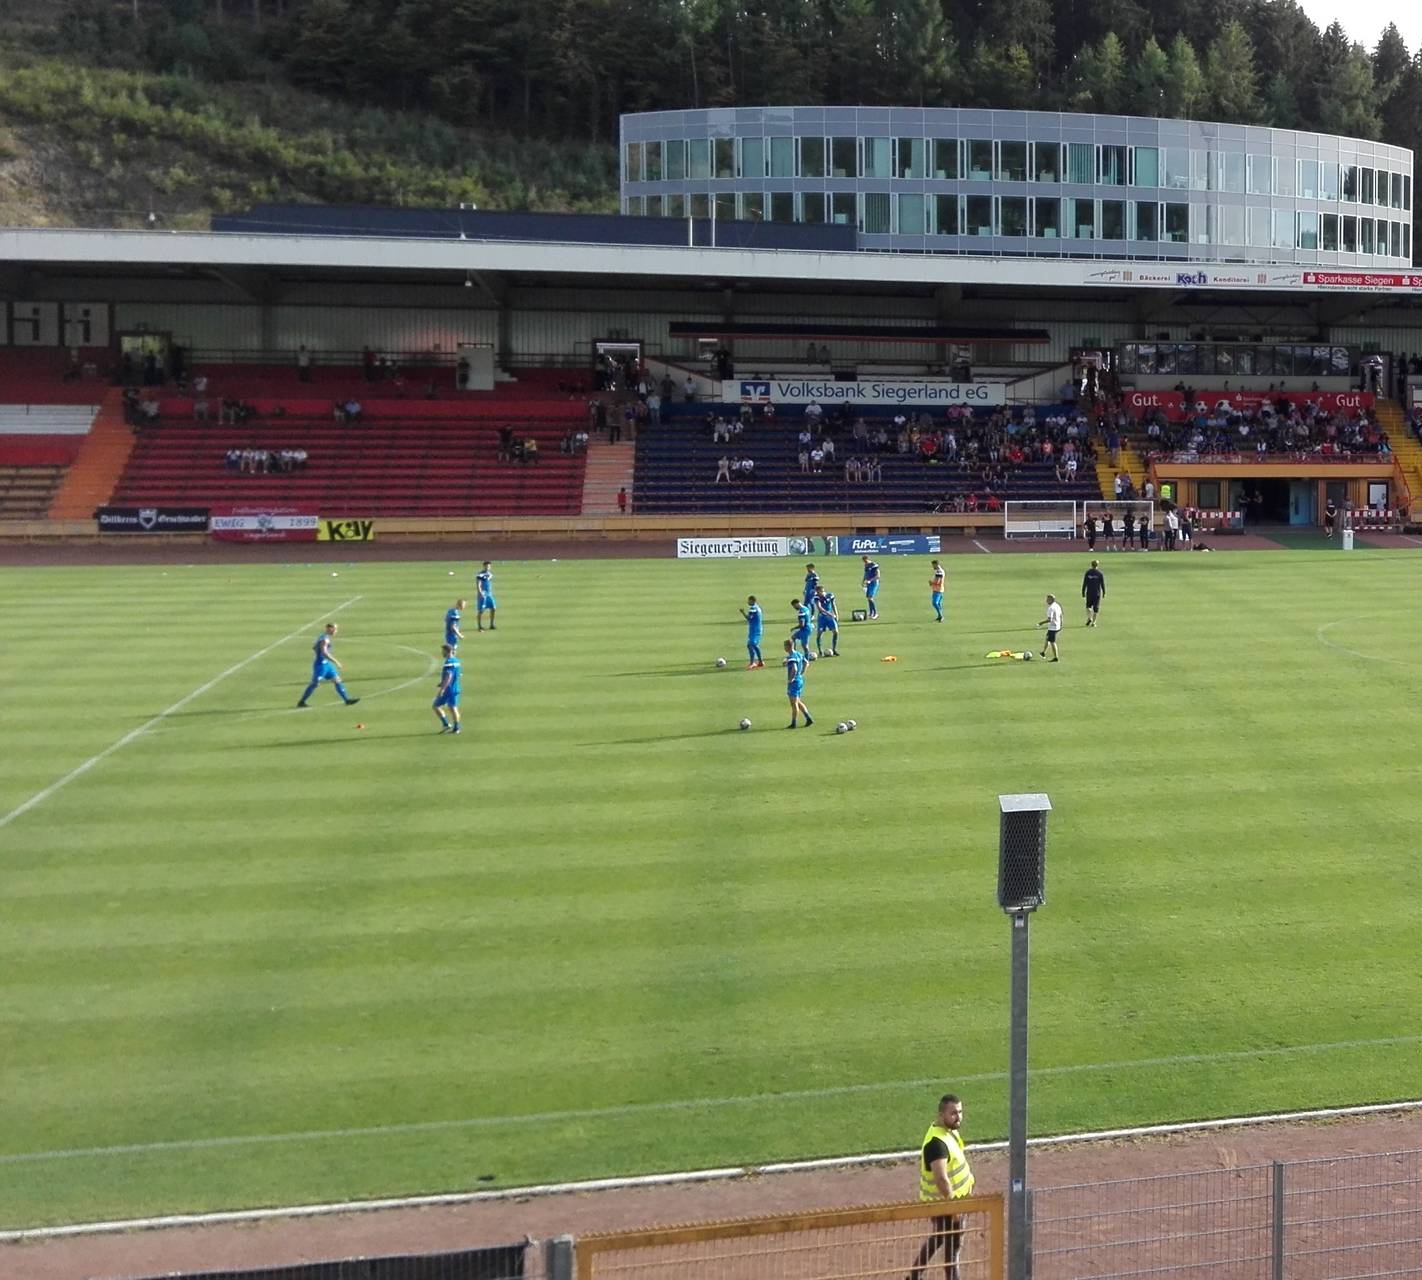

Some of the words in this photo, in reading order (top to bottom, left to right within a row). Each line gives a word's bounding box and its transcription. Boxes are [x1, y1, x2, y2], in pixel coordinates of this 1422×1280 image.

[1139, 273, 1171, 281] Bäckerei
[1176, 271, 1207, 286] Koch
[1213, 275, 1250, 283] Konditorei
[1318, 274, 1363, 285] Sparkasse
[1364, 275, 1394, 286] Siegen
[777, 383, 866, 400] Volksbank
[872, 384, 960, 402] Siegerland
[965, 385, 989, 400] eG
[289, 518, 316, 527] 1899
